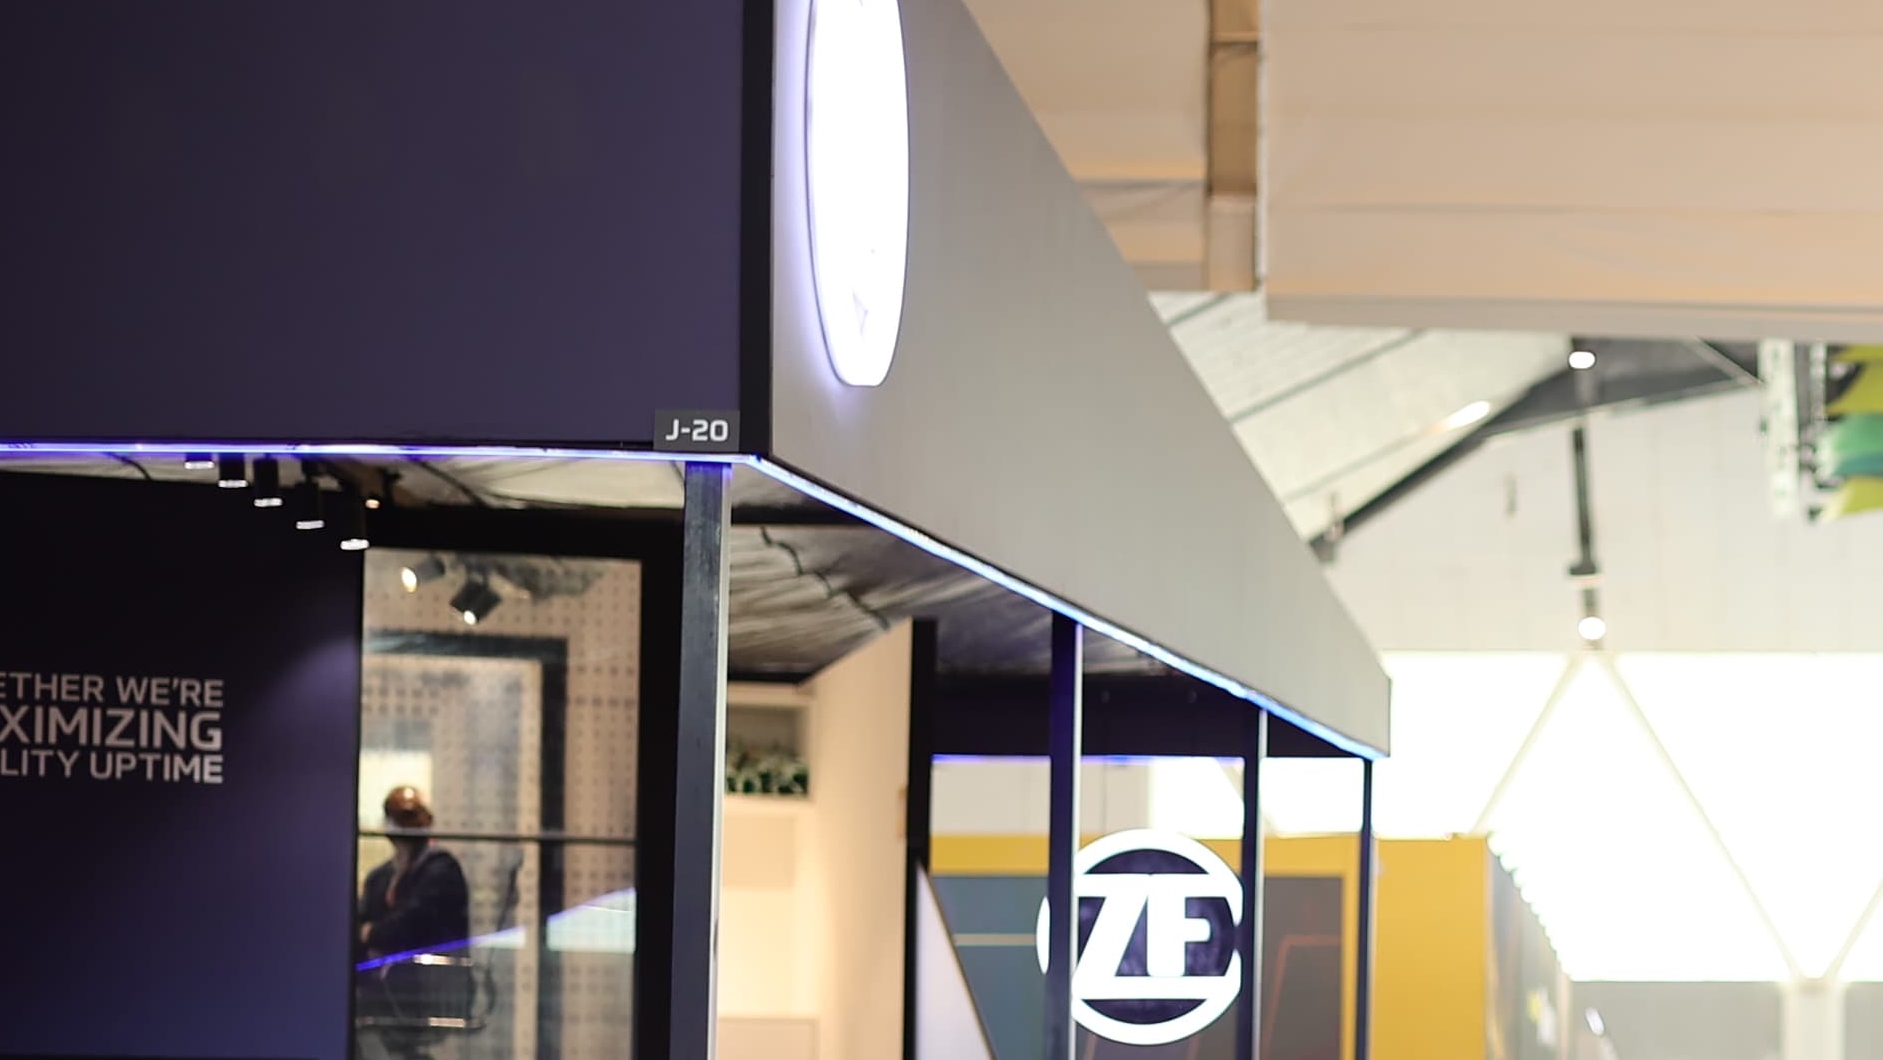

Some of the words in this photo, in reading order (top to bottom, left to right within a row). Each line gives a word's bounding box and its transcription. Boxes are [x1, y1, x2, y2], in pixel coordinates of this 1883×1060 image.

[665, 419, 729, 442] J-20
[116, 676, 224, 707] WE'RE
[0, 705, 223, 750] XIMIZING
[0, 749, 79, 778] LITY
[90, 752, 224, 784] UPTIME
[1072, 872, 1243, 1000] ZF
